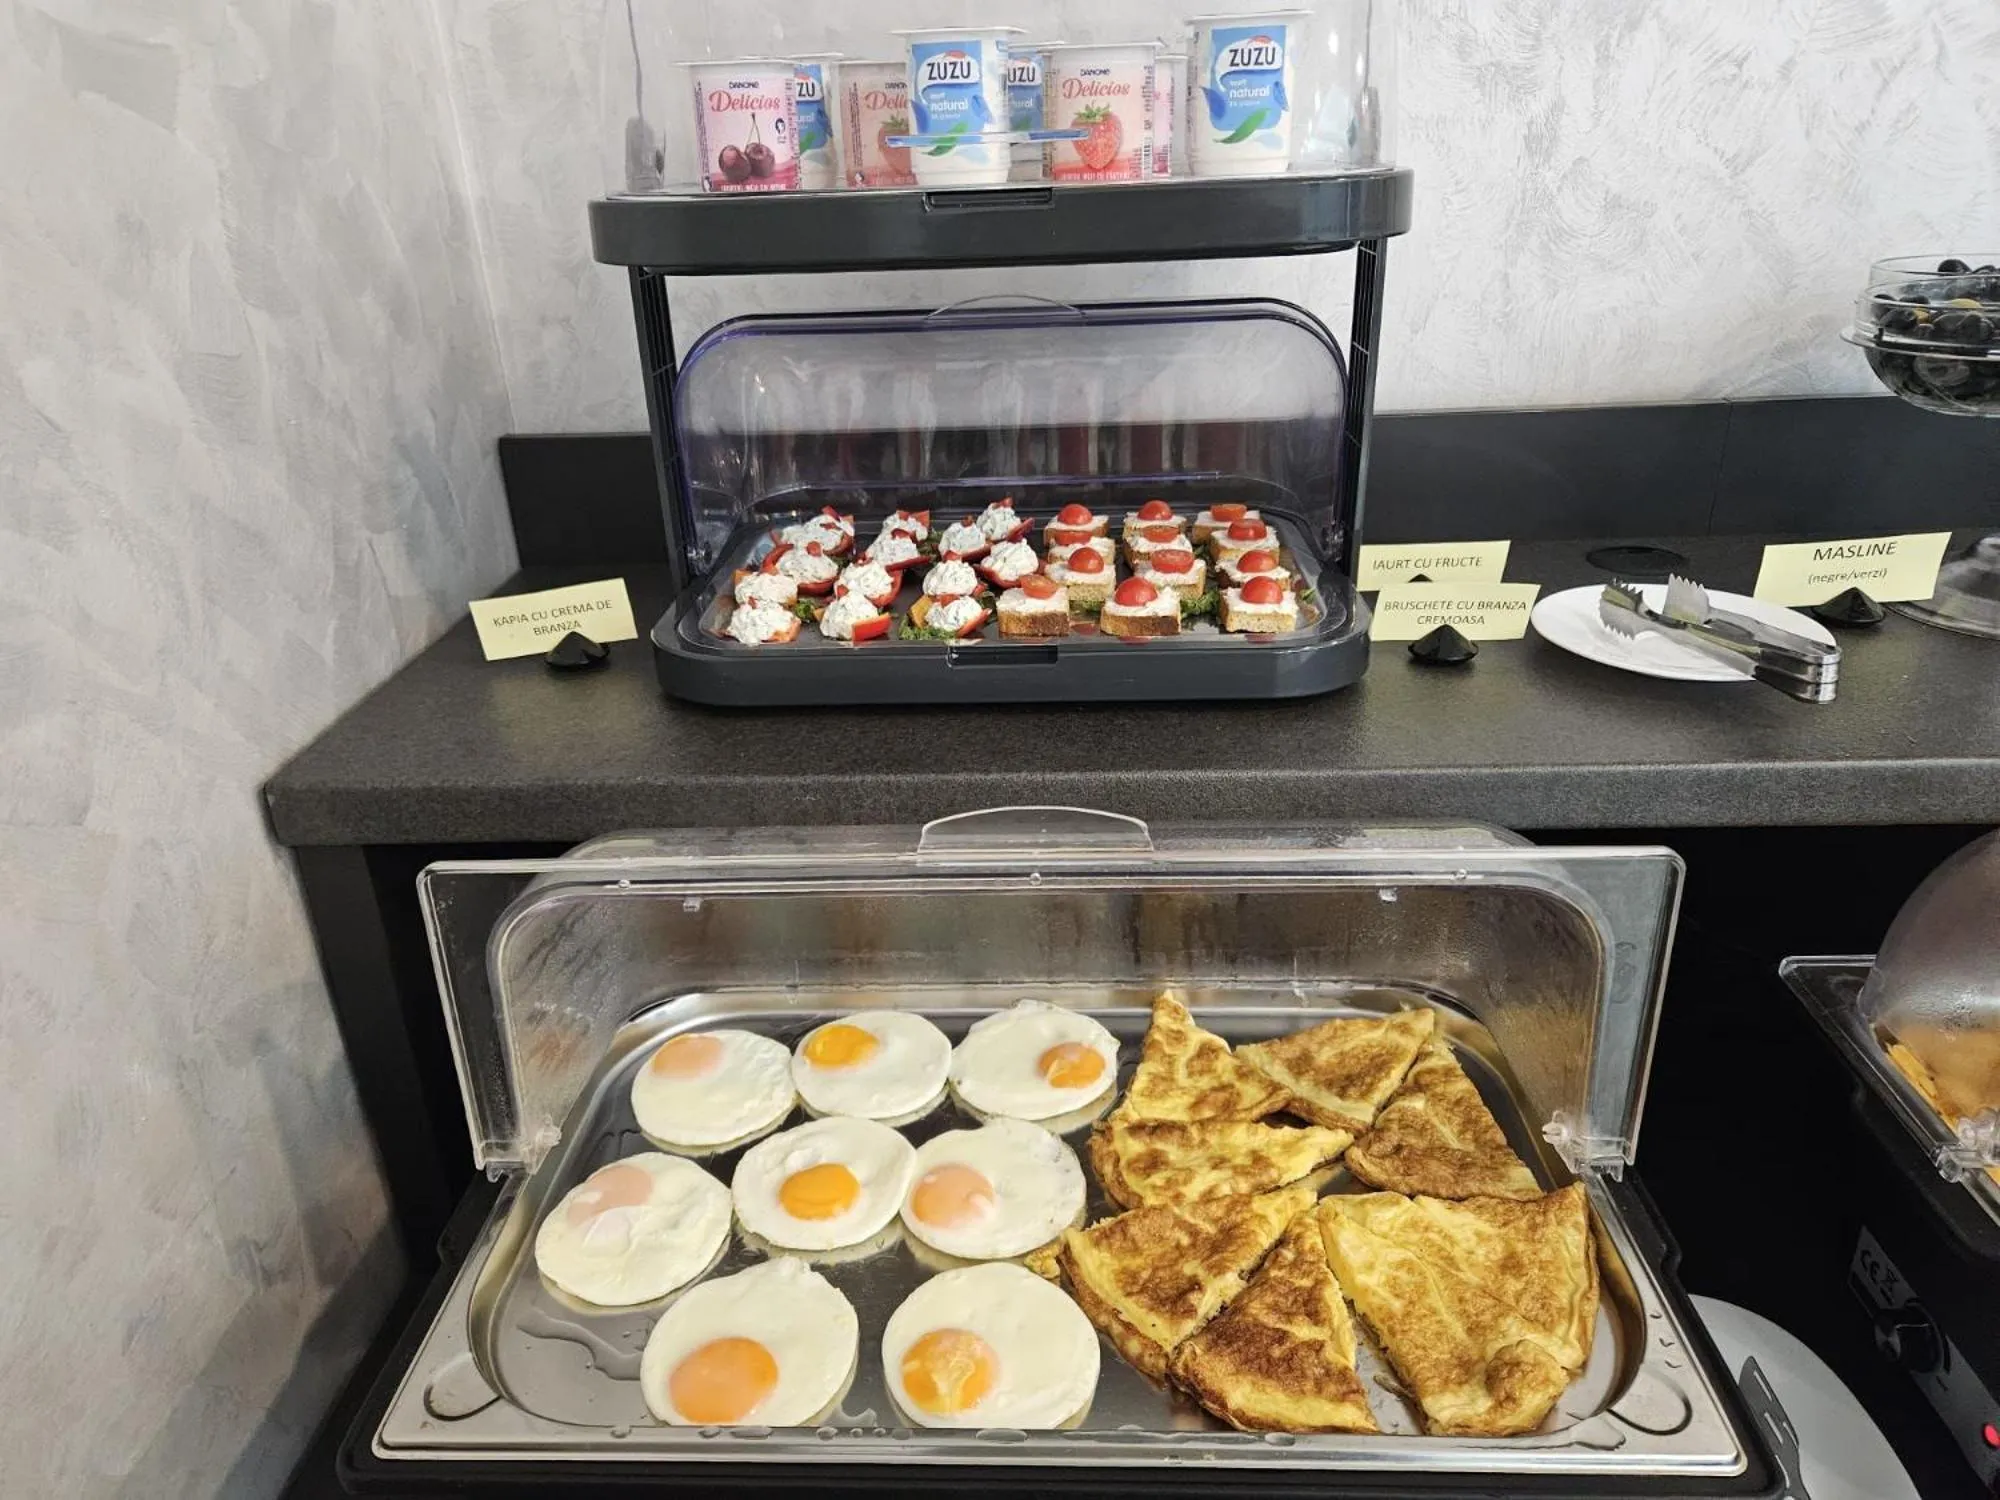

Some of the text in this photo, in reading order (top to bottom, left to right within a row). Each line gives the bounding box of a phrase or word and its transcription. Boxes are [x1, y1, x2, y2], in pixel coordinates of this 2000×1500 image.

[1229, 47, 1276, 67] ZUZU
[926, 61, 971, 81] ZUZU
[1007, 66, 1036, 83] UZU
[796, 82, 816, 97] ZU
[1062, 78, 1131, 99] Delicios
[1230, 85, 1270, 99] natural
[709, 90, 781, 112] Delicios
[865, 91, 908, 110] Deli
[931, 97, 969, 112] natural
[1813, 541, 1898, 561] MASLINE
[1373, 556, 1483, 570] IAURT CU FRUCTE
[1808, 567, 1888, 584] (negre/verzi)
[492, 600, 613, 627] KAPIA CU CREMA DE
[1384, 600, 1527, 611] BRUSCHETE CU BRANZA
[533, 620, 582, 636] BRANZA
[1417, 615, 1485, 625] CREMOASA
